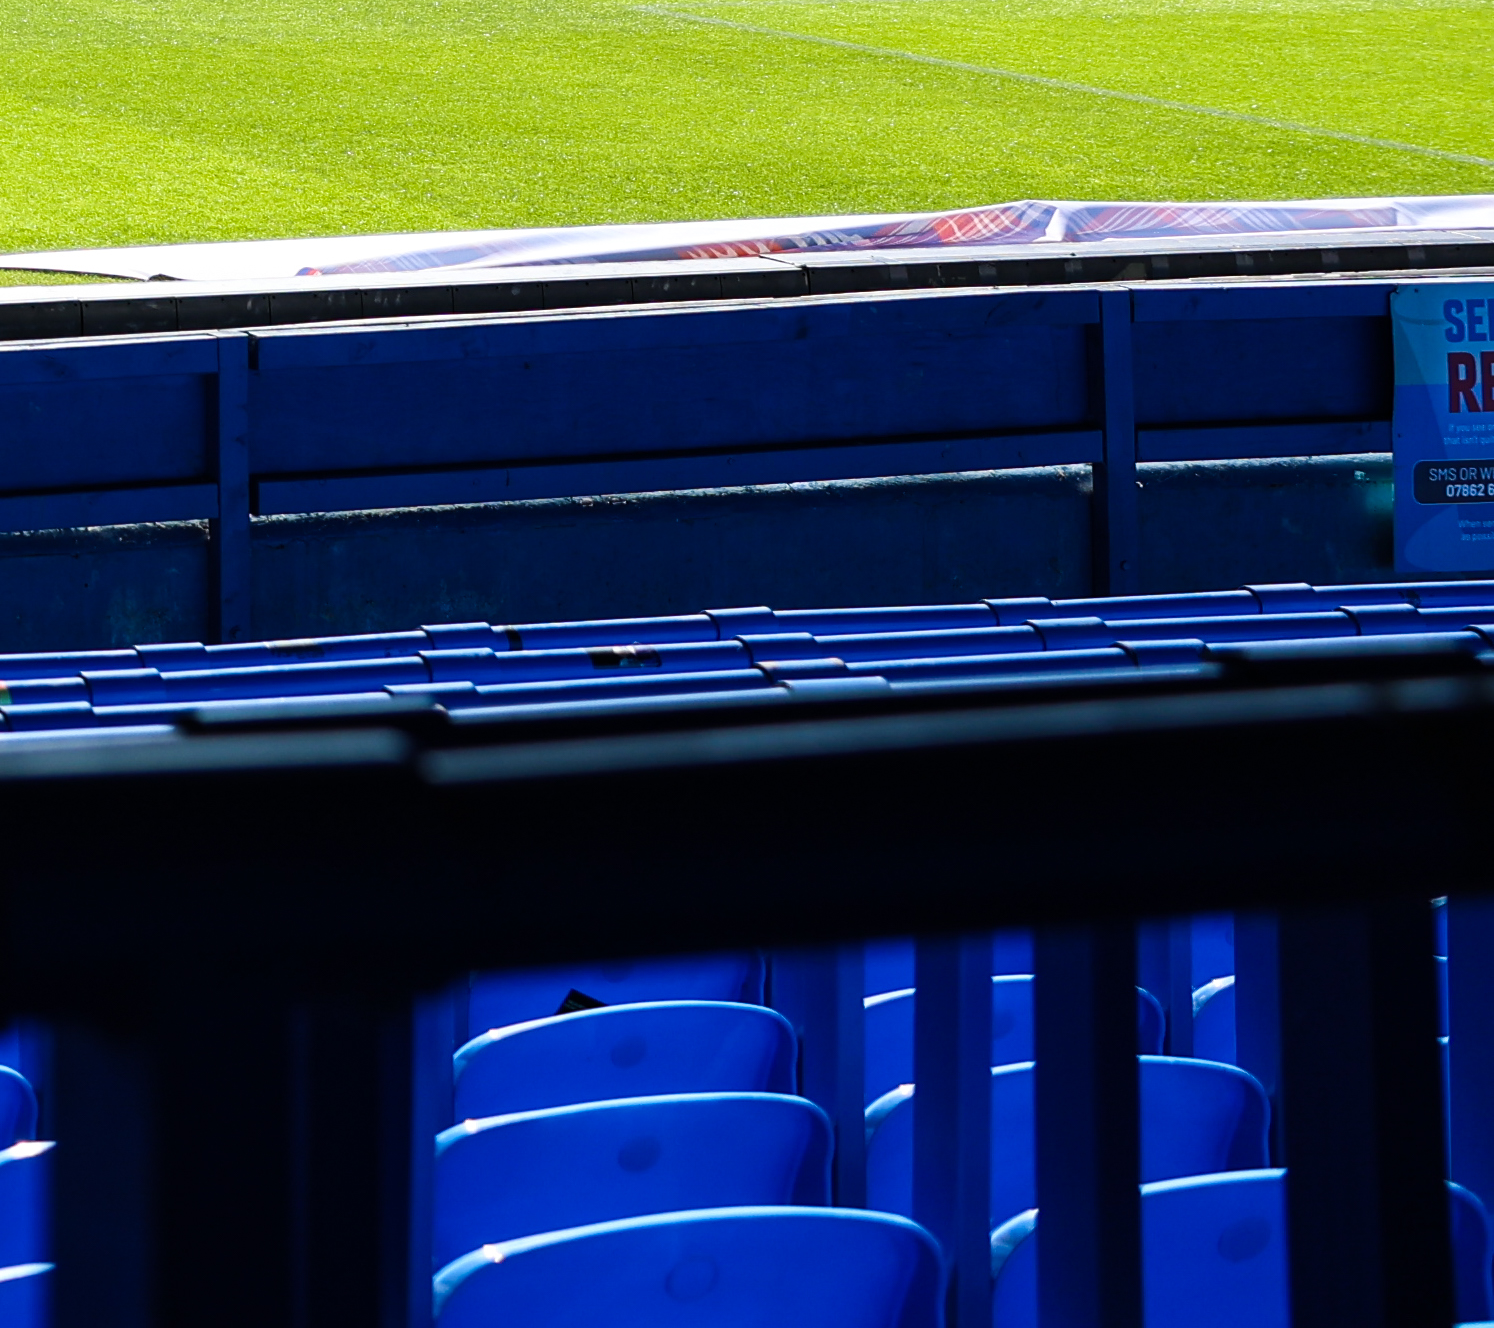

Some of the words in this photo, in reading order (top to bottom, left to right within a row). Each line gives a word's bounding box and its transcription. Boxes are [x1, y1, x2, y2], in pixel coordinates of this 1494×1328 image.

[1429, 467, 1457, 481] SMS
[1459, 467, 1478, 481] OR
[1480, 466, 1494, 480] W
[1445, 484, 1485, 498] 07862
